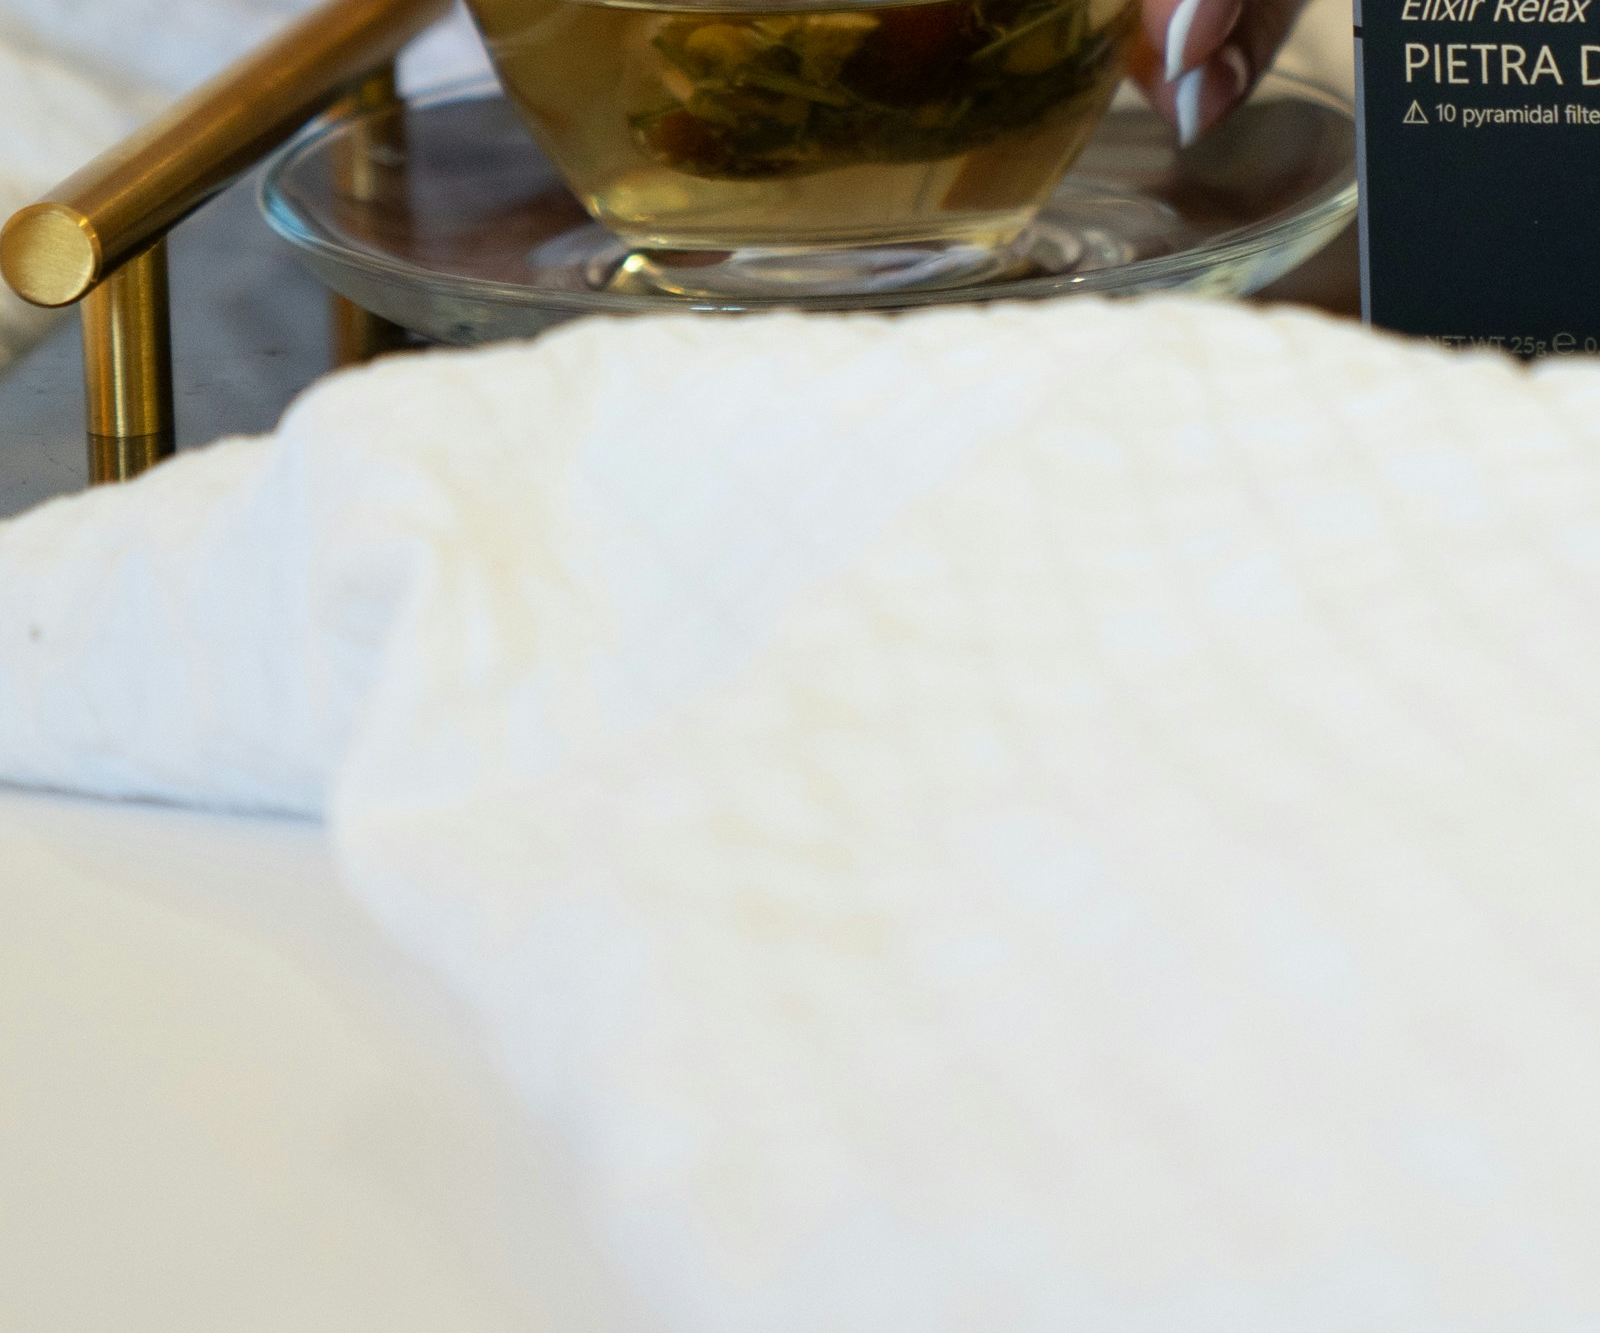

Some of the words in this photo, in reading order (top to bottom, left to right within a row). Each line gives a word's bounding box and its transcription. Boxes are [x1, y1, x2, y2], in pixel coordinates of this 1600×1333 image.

[1403, 42, 1564, 86] PIETRA
[1435, 103, 1457, 123] 10
[1462, 104, 1559, 128] pyramidal
[1510, 336, 1548, 358] 25g
